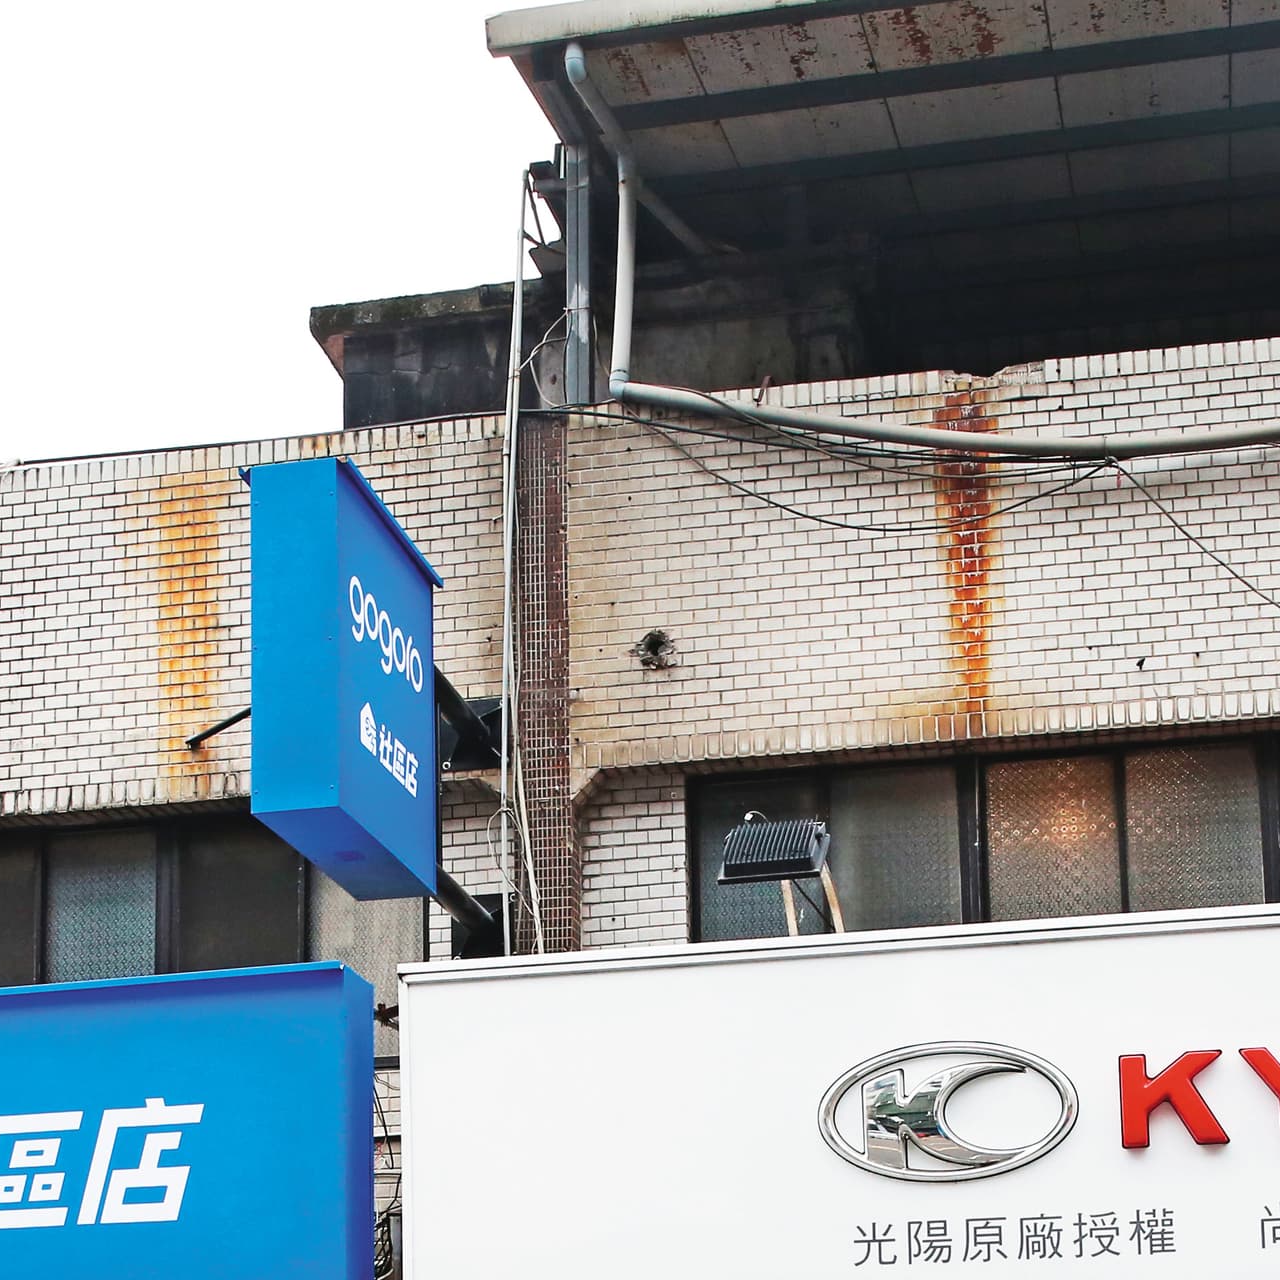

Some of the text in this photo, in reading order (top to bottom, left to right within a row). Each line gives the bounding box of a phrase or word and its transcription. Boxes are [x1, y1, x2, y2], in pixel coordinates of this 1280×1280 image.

[349, 575, 423, 693] gogoro
[378, 724, 418, 798] 社區店
[852, 1207, 1177, 1269] 光陽原廠授權
